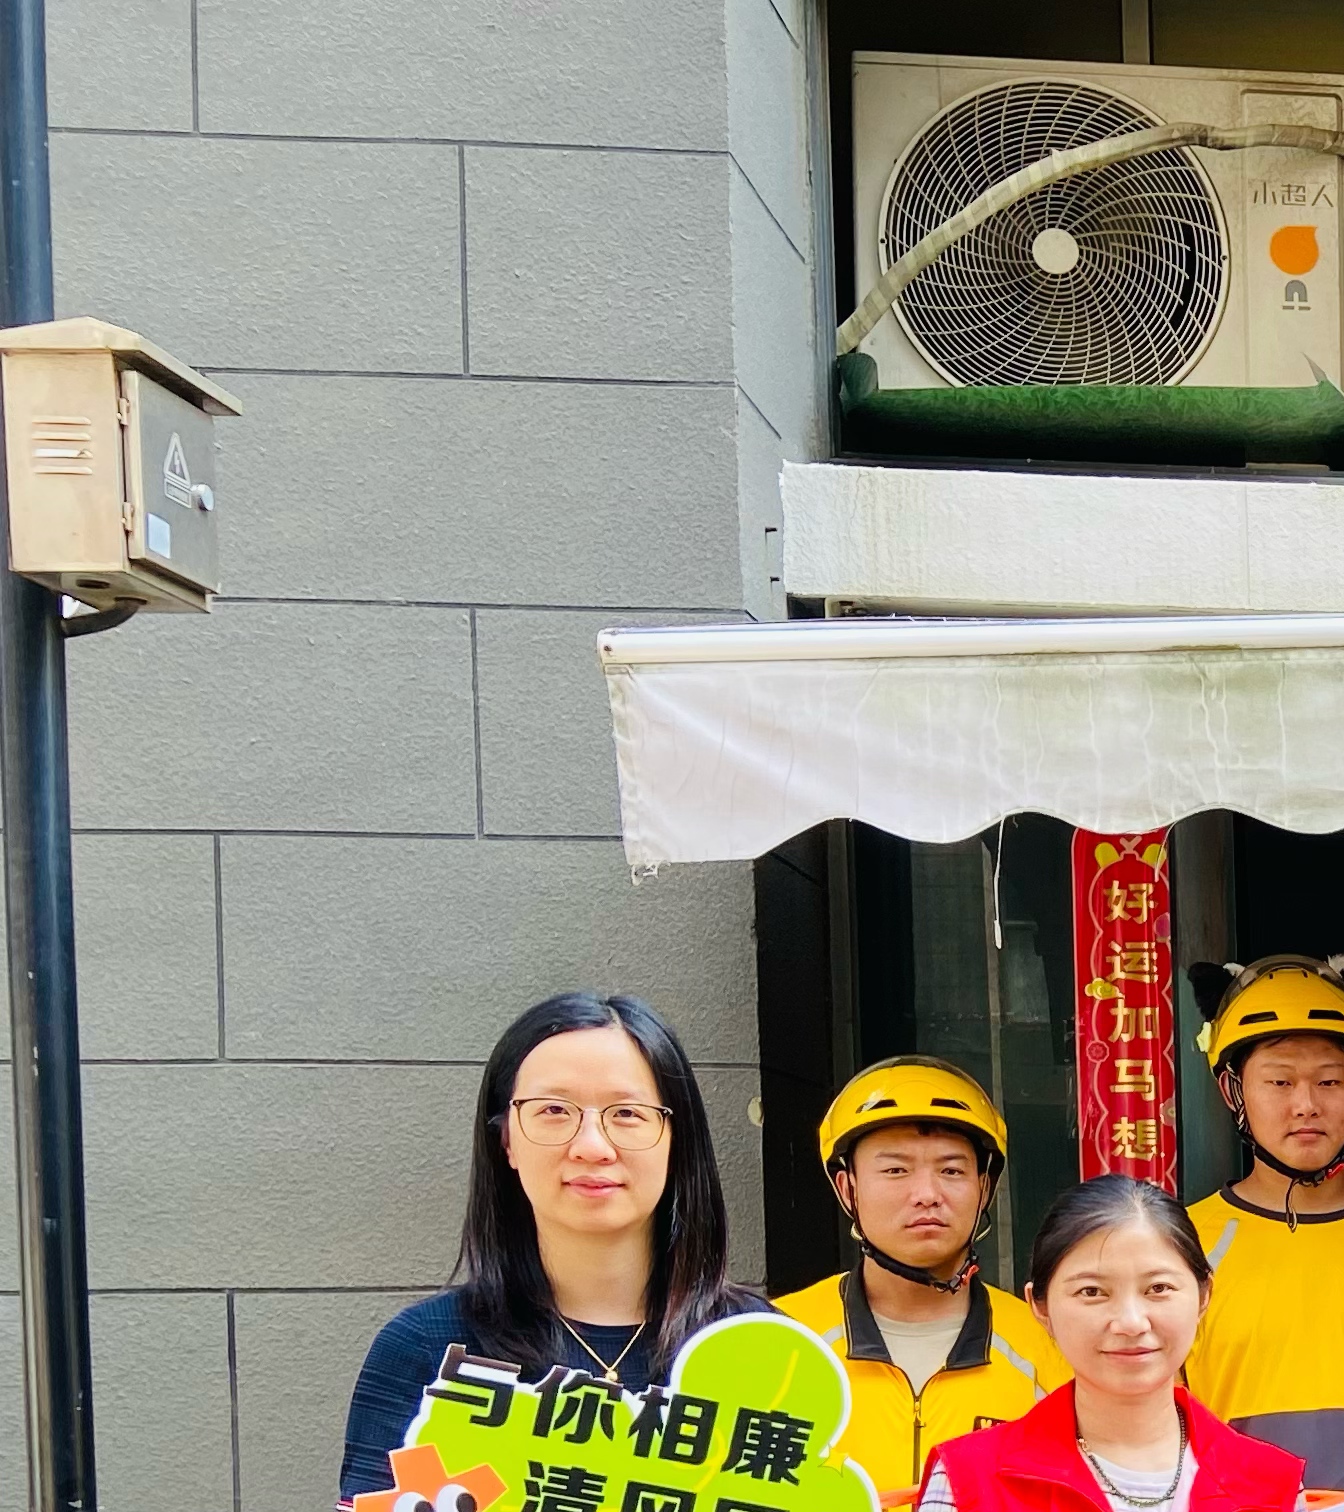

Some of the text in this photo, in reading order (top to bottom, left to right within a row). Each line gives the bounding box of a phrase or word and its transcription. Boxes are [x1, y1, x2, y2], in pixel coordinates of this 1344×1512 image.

[1252, 182, 1334, 209] 小超人
[426, 343, 815, 485] 与你相廉
[1104, 880, 1161, 1175] 好运加马想
